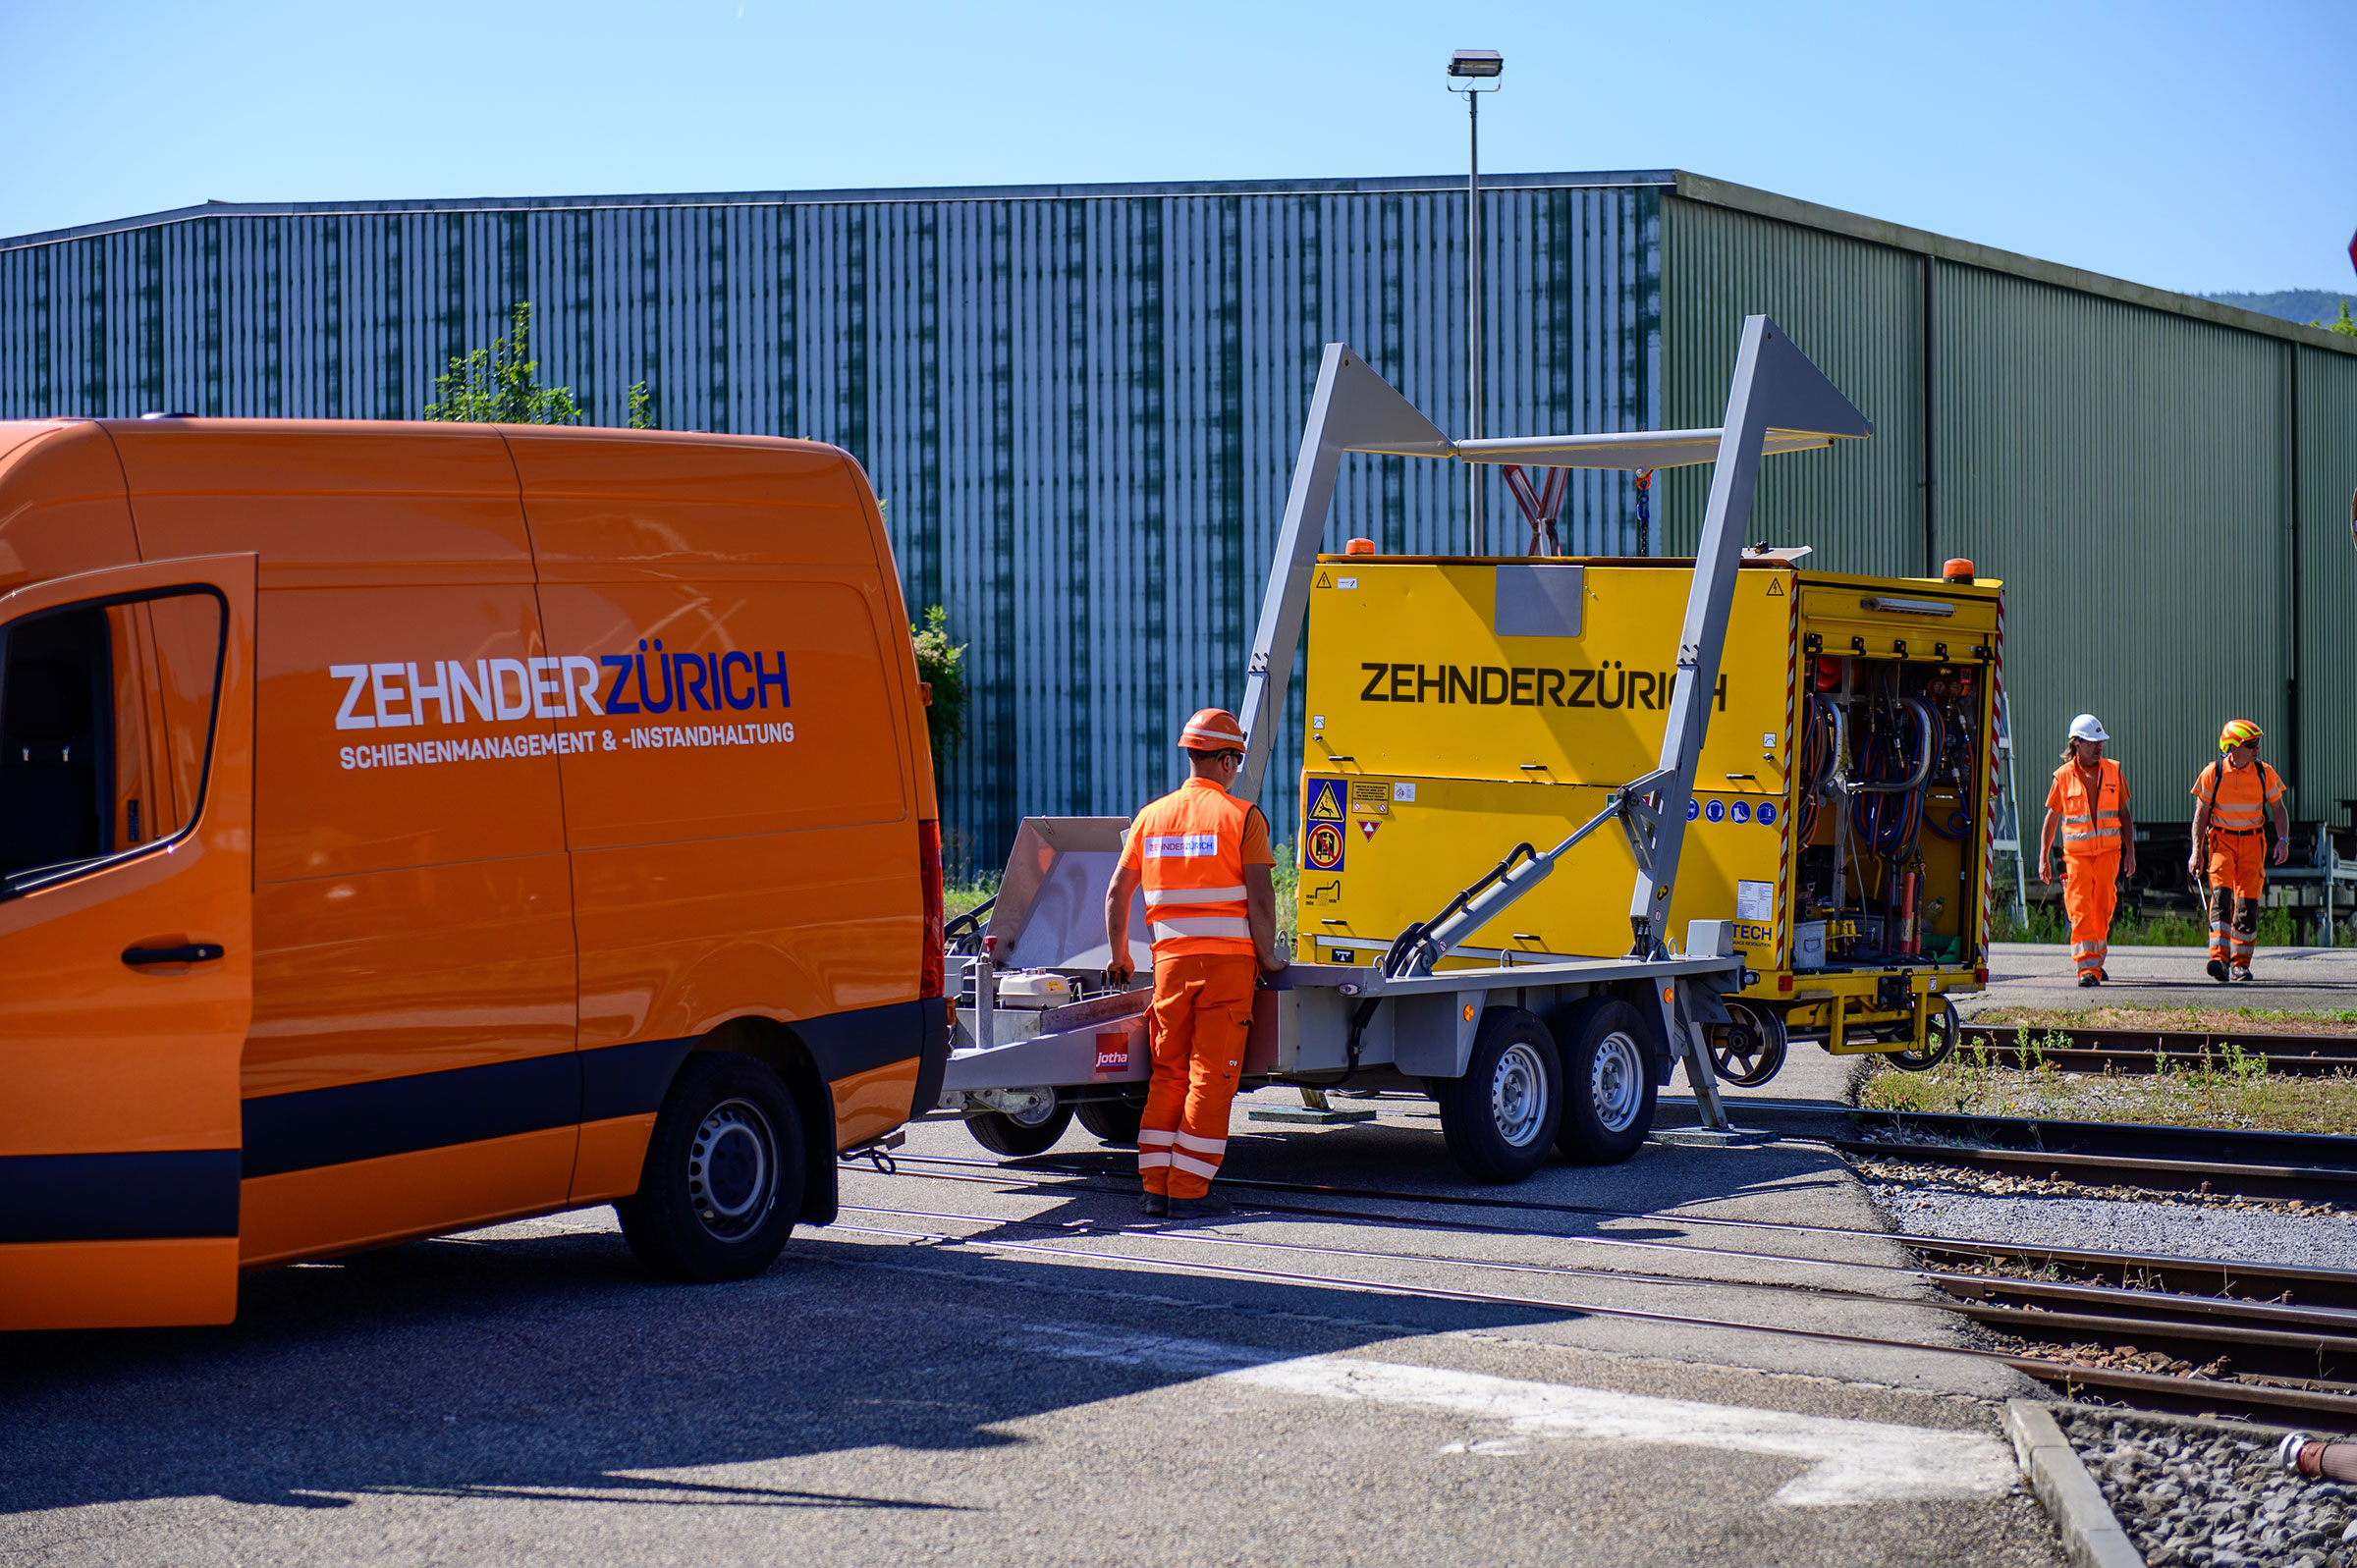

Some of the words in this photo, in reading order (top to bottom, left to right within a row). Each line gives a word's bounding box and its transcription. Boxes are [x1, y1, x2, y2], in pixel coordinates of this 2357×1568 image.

[329, 638, 791, 730] ZEHNDERZÜRICH
[1360, 659, 1727, 712] ZEHNDERZÜRIH
[340, 730, 596, 770] SCHIENENMANAGEMENT
[602, 729, 618, 751] &
[622, 723, 795, 750] -INSTANDHALTUNG
[1095, 1052, 1127, 1067] jotha
